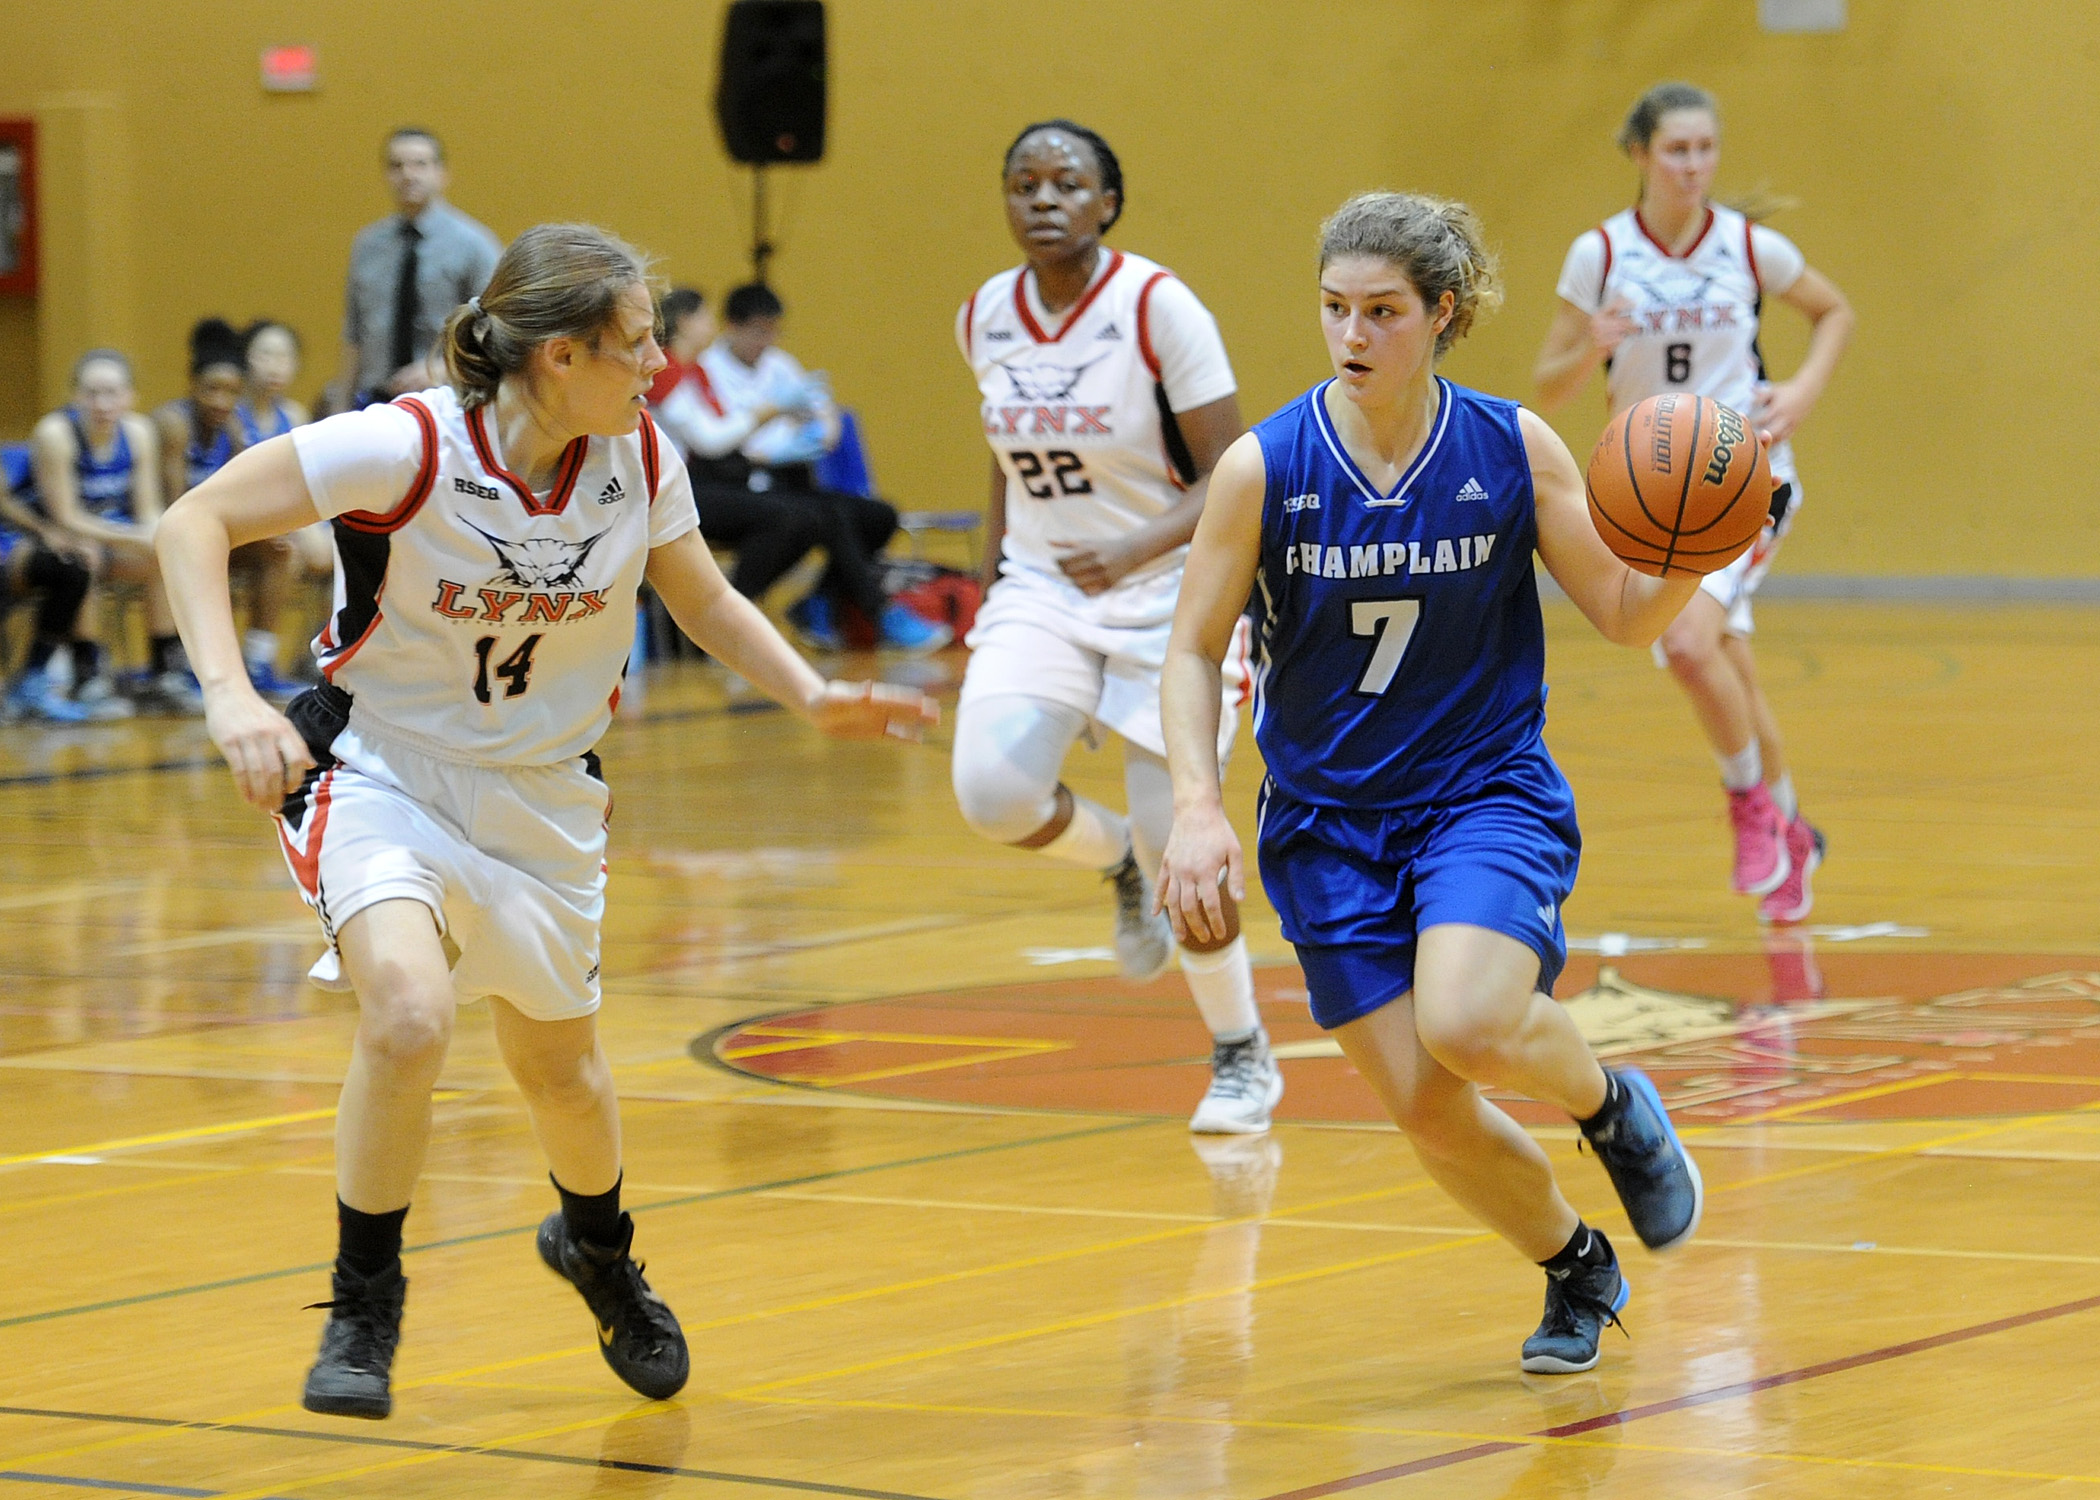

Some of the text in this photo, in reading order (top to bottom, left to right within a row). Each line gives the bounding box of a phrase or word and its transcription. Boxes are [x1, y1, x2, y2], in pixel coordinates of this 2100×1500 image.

[1640, 304, 1737, 334] YNX
[984, 404, 1113, 435] LYNX
[1009, 449, 1094, 499] 22
[1455, 491, 1489, 502] adidas
[1285, 533, 1497, 579] CHAMPLAIN
[432, 578, 615, 622] LYNX
[472, 632, 547, 706] 14
[1350, 598, 1421, 696] 7
